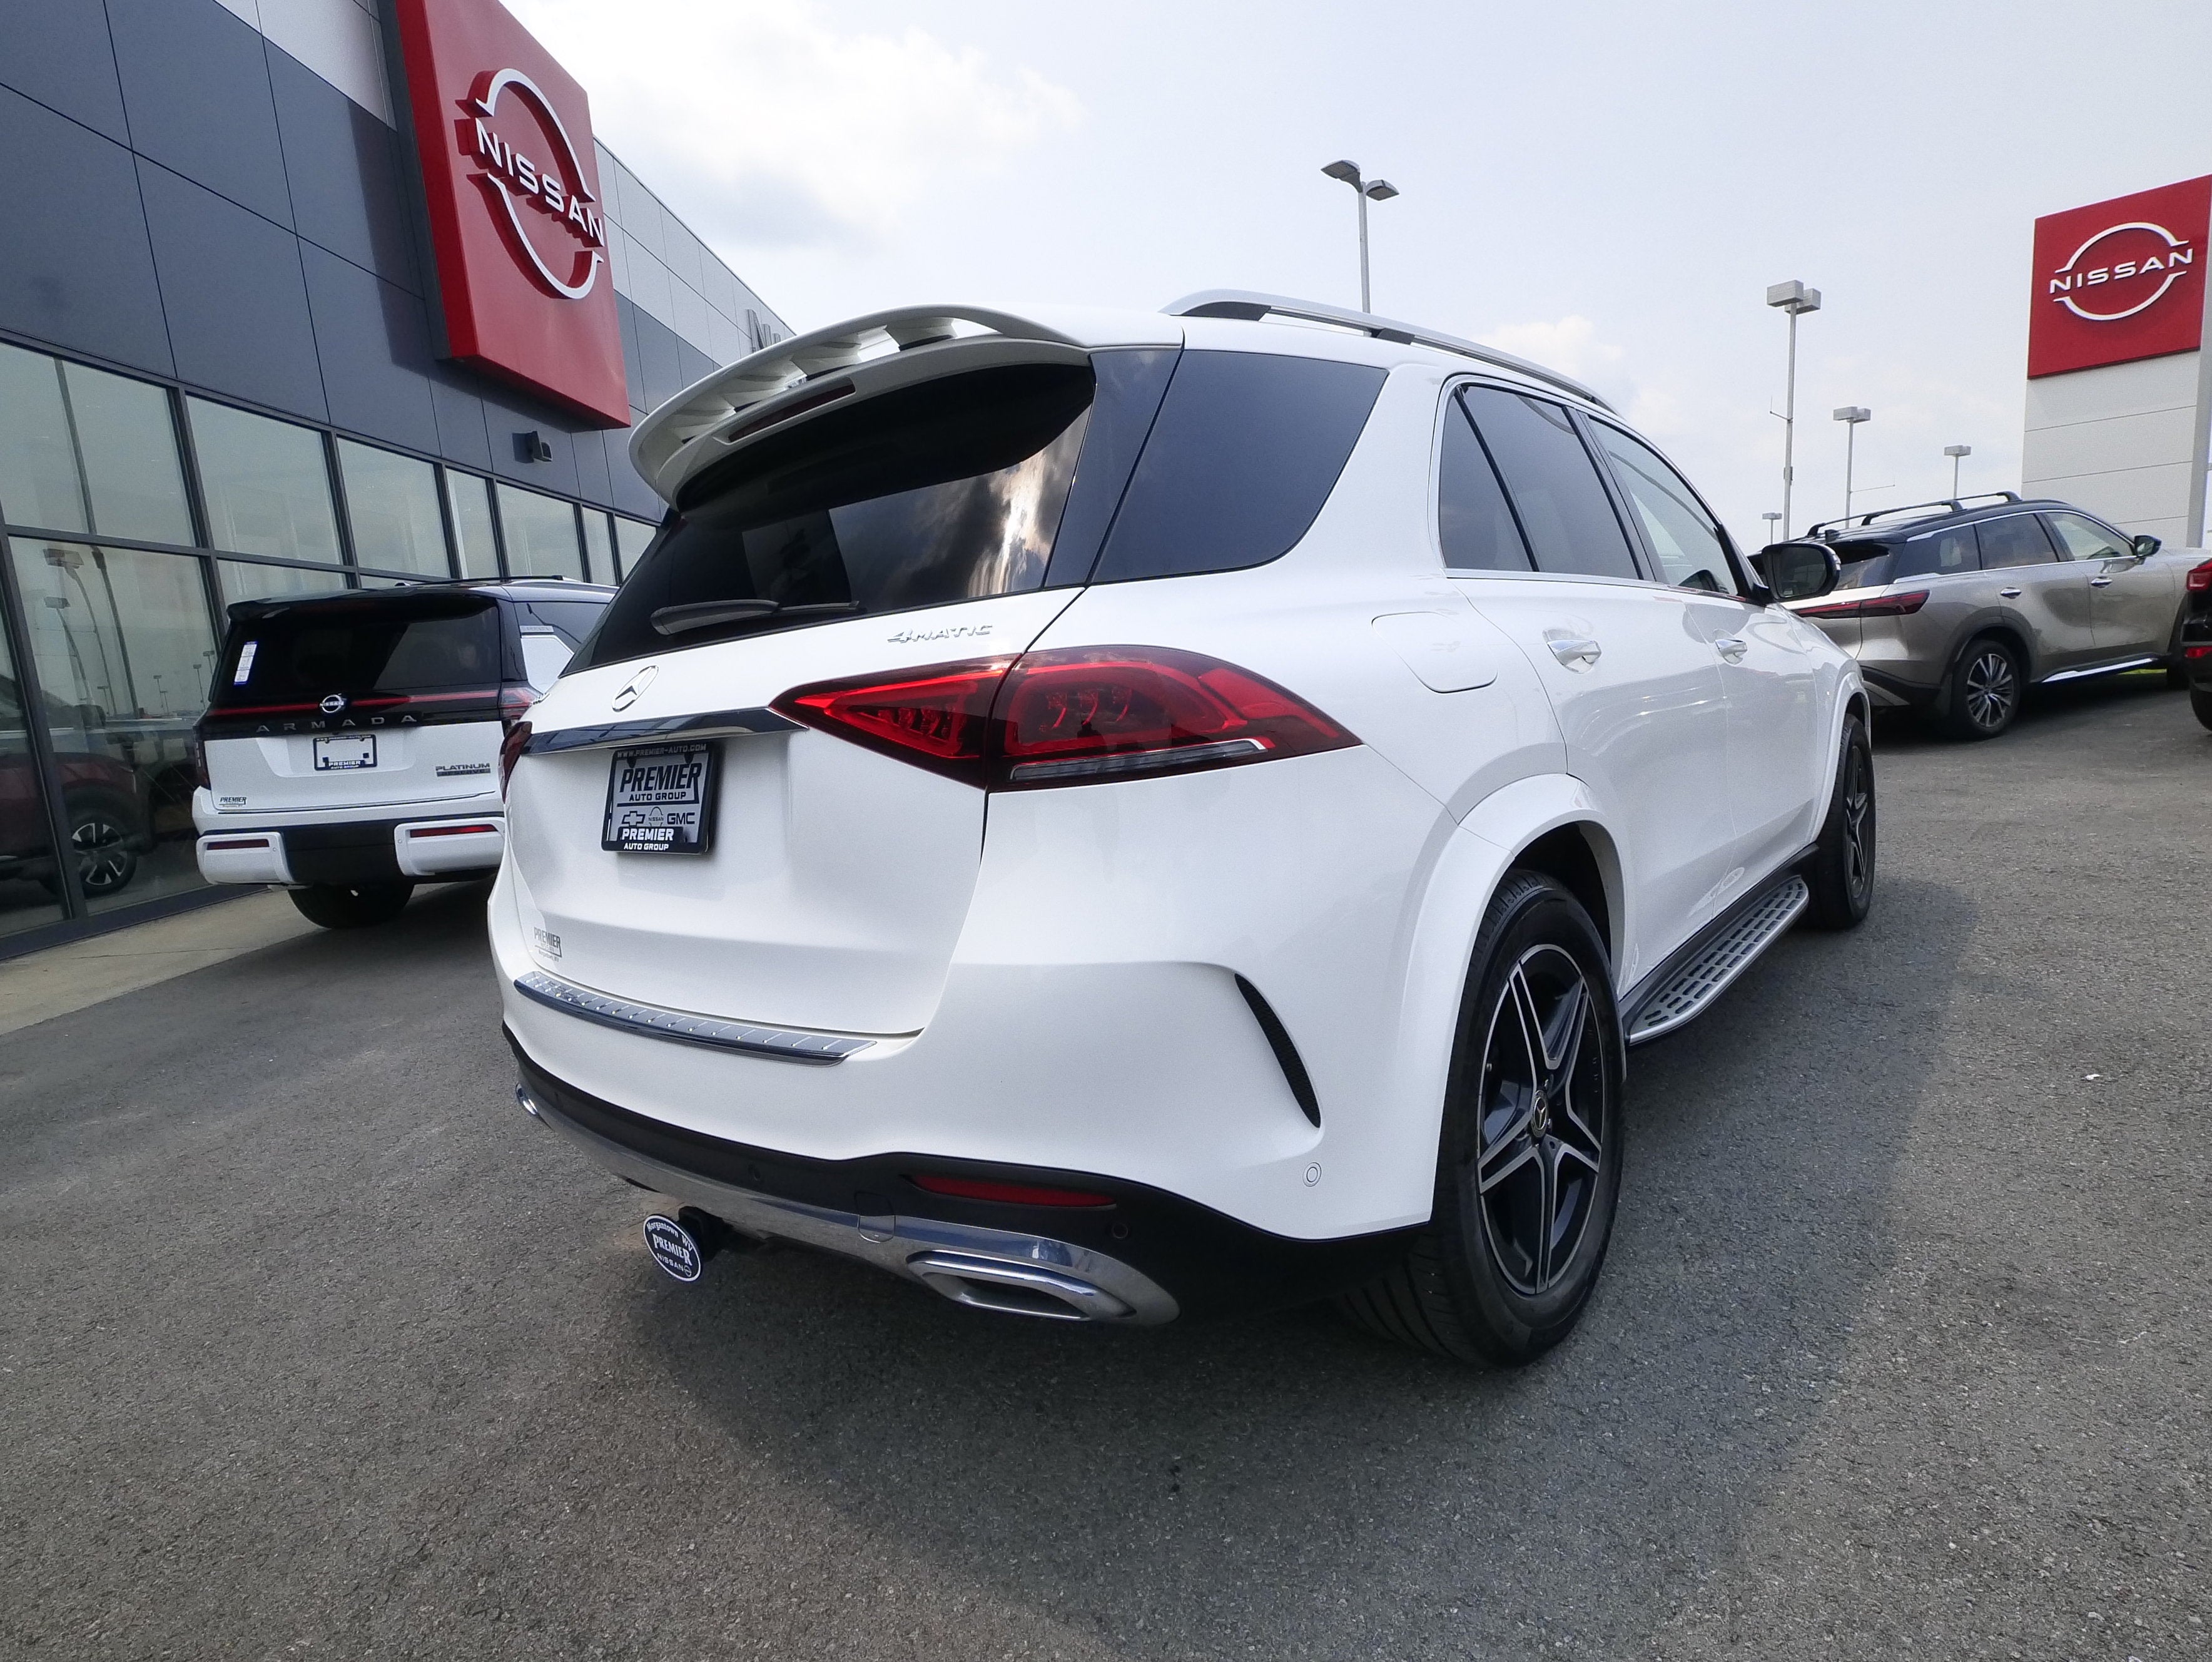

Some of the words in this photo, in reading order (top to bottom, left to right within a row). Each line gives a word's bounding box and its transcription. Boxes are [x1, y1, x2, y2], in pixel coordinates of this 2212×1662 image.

[476, 117, 604, 247] NISSAN
[2049, 248, 2193, 294] NISSAN
[887, 625, 993, 643] 4MATIC
[256, 715, 417, 733] ARMADA
[617, 743, 707, 758] WWW.PREMIER-AUTO.COM
[435, 763, 490, 771] PLATINUM
[619, 763, 703, 795] PREMIER
[629, 793, 652, 802] AUTO
[655, 792, 687, 801] GROUP
[667, 812, 696, 825] GMC
[622, 828, 674, 841] PREMIER
[534, 927, 561, 949] PREMIER
[652, 1233, 693, 1266] PREMIER
[657, 1253, 684, 1272] NISSAN
